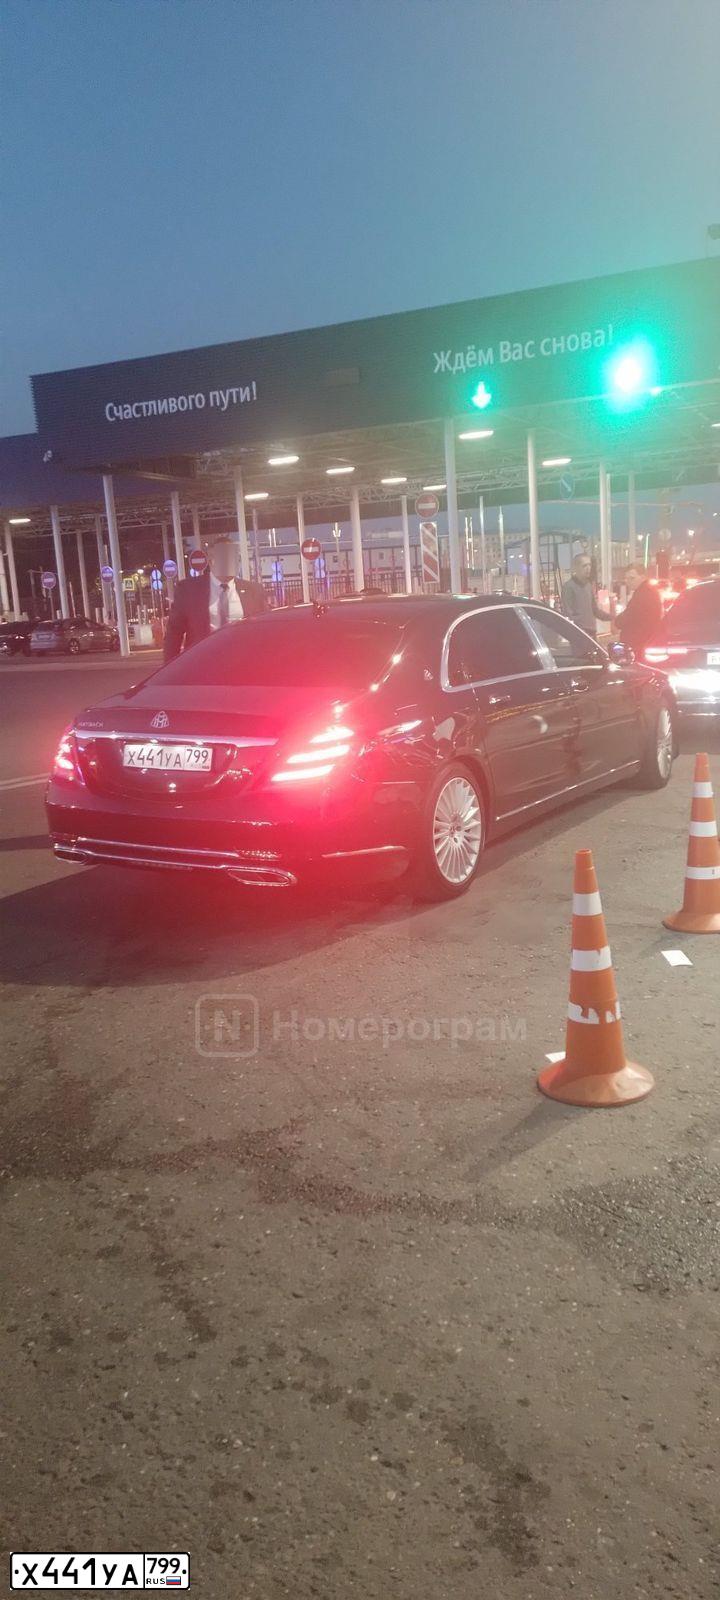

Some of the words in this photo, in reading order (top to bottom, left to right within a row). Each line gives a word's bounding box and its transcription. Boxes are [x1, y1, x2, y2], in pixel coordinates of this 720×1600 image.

[433, 345, 494, 374] Ждём
[499, 340, 536, 363] Вас
[540, 323, 614, 356] снова!
[105, 392, 205, 422] Счастливого
[209, 380, 257, 411] пути!
[186, 748, 209, 764] 799
